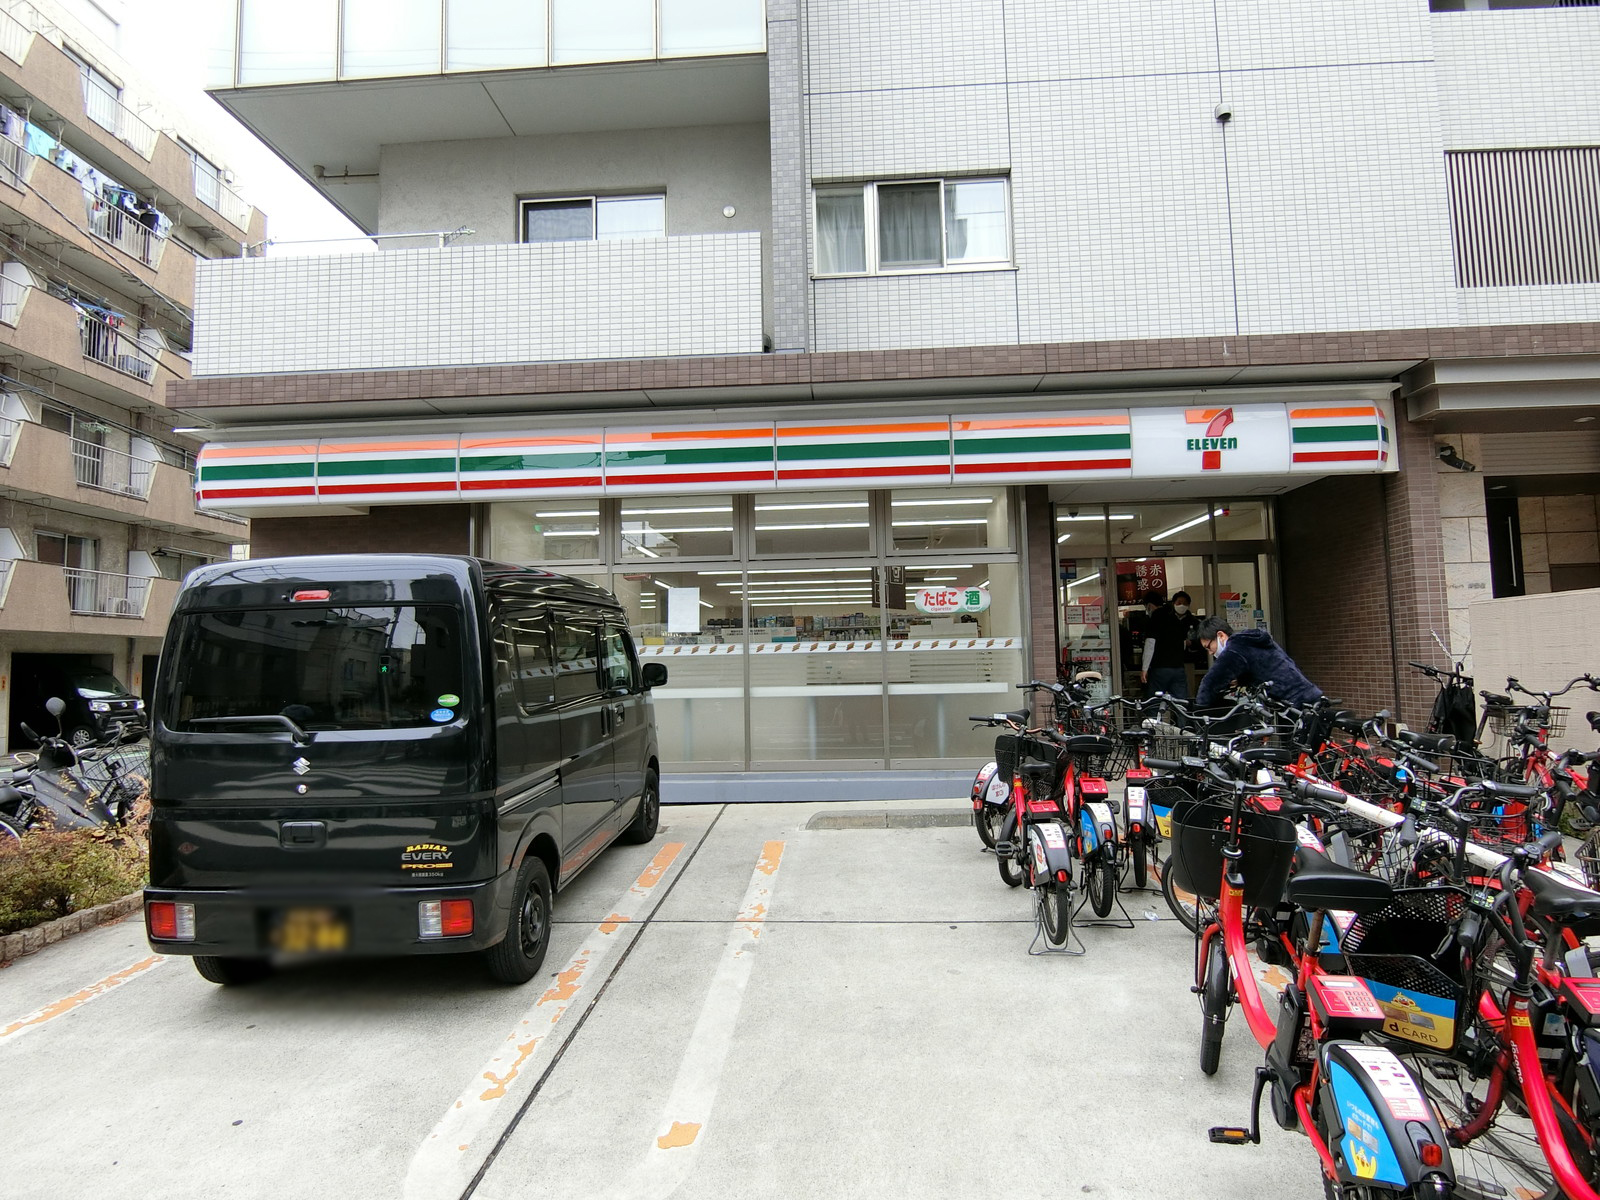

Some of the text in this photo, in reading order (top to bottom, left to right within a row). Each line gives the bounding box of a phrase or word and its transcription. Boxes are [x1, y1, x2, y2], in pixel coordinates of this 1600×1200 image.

[1135, 564, 1150, 591] 誘惑
[1149, 563, 1164, 589] 赤の
[923, 590, 981, 607] たばこ 酒
[401, 851, 453, 861] EVERY
[405, 843, 448, 853] RADIAL
[1401, 1026, 1439, 1044] CARD
[1509, 1039, 1525, 1084] docomo
